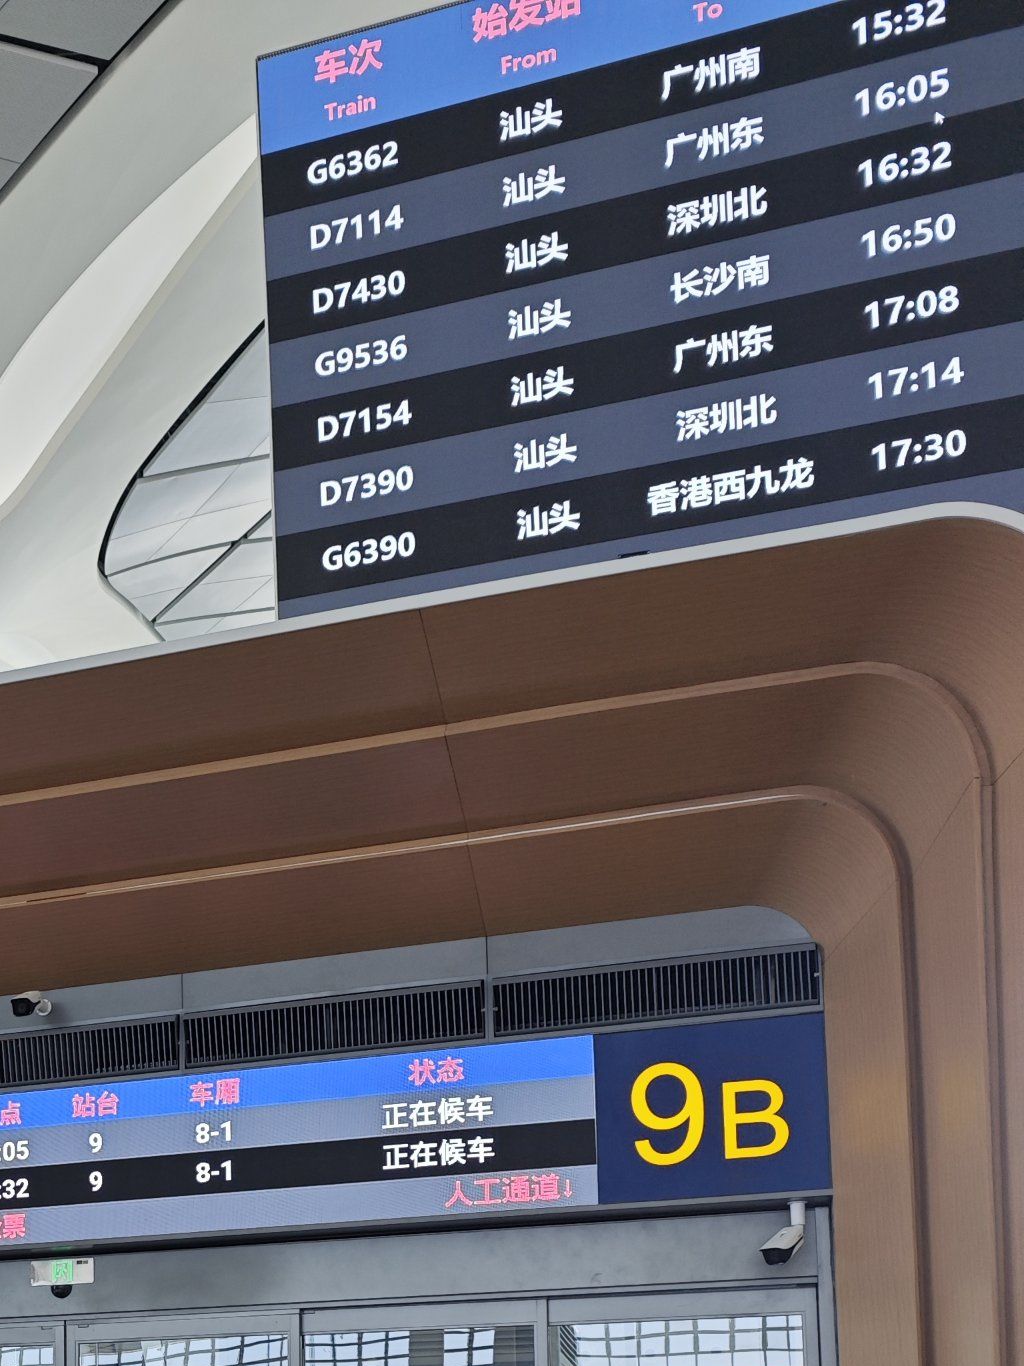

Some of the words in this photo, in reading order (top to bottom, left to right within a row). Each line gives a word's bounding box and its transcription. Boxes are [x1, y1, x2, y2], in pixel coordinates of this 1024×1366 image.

[308, 141, 398, 183] G6362
[500, 99, 562, 140] 汕头
[662, 47, 760, 99] 广州南
[853, 0, 945, 44] 15:32
[314, 40, 383, 85] 车次
[324, 93, 377, 122] Train
[500, 47, 557, 75] From
[692, 2, 723, 23] To
[311, 205, 403, 249] D7114
[503, 165, 565, 206] 汕头
[665, 117, 764, 167] 广州东
[855, 68, 950, 118] 16:05
[313, 271, 405, 313] D7430
[506, 232, 568, 273] 汕头
[668, 185, 767, 235] 深圳北
[859, 142, 951, 186] 16:32
[315, 335, 407, 375] G9536
[509, 299, 571, 339] 汕头
[671, 255, 769, 303] 长沙南
[862, 214, 955, 257] 16:50
[318, 400, 412, 441] D7154
[511, 366, 574, 406] 汕头
[674, 325, 773, 372] 广州东
[865, 286, 959, 328] 17:08
[321, 466, 413, 506] D7390
[514, 434, 576, 472] 汕头
[677, 394, 777, 441] 深圳北
[869, 357, 964, 399] 17:14
[323, 532, 415, 570] G6390
[517, 501, 580, 539] 汕头
[648, 458, 814, 515] 香港西九龙
[872, 430, 966, 470] 17:30
[72, 1093, 119, 1117] 站台
[190, 1078, 240, 1108] 车厢
[408, 1057, 464, 1085] 状态
[89, 1133, 102, 1153] 9
[196, 1121, 231, 1143] 8-1
[382, 1095, 493, 1129] 正在候车
[631, 1063, 789, 1165] 9B
[90, 1171, 102, 1191] 9
[196, 1161, 231, 1182] 8-1
[383, 1134, 494, 1169] 正在候车
